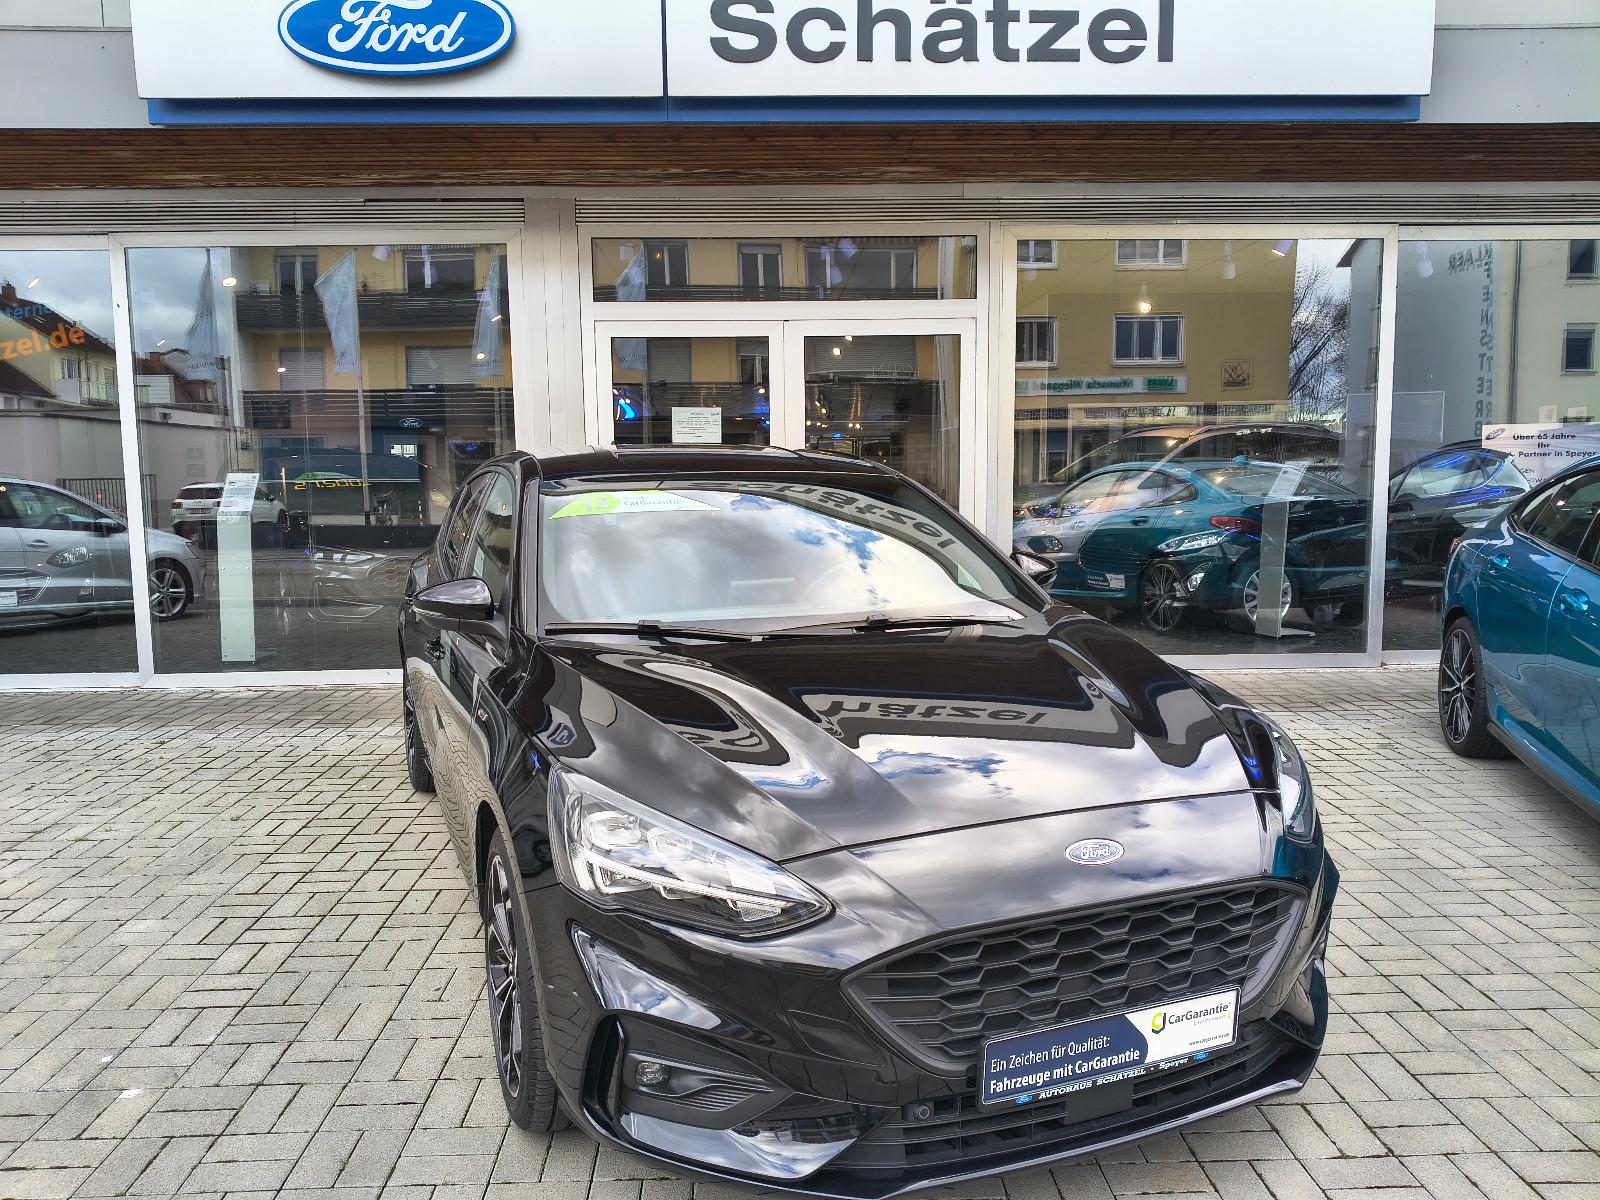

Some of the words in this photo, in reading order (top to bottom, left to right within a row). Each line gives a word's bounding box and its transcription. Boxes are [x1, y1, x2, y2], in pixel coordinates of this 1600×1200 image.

[326, 0, 468, 53] Ford
[709, 0, 1175, 64] Schätzel
[0, 322, 86, 360] zel.de
[1513, 433, 1535, 441] Über
[1565, 450, 1598, 458] Speyer
[1168, 1003, 1229, 1024] CarGarantie
[990, 1070, 1050, 1094] Fahrzeuge
[1053, 1063, 1073, 1079] mit
[1075, 1048, 1140, 1074] CarGarantie
[991, 1058, 1007, 1073] Ein
[1009, 1051, 1049, 1069] Zeichen
[1051, 1045, 1066, 1060] für
[1068, 1035, 1111, 1056] Qualität:
[1038, 1080, 1093, 1100] AUTOHAUS
[1158, 1057, 1189, 1070] Speyer
